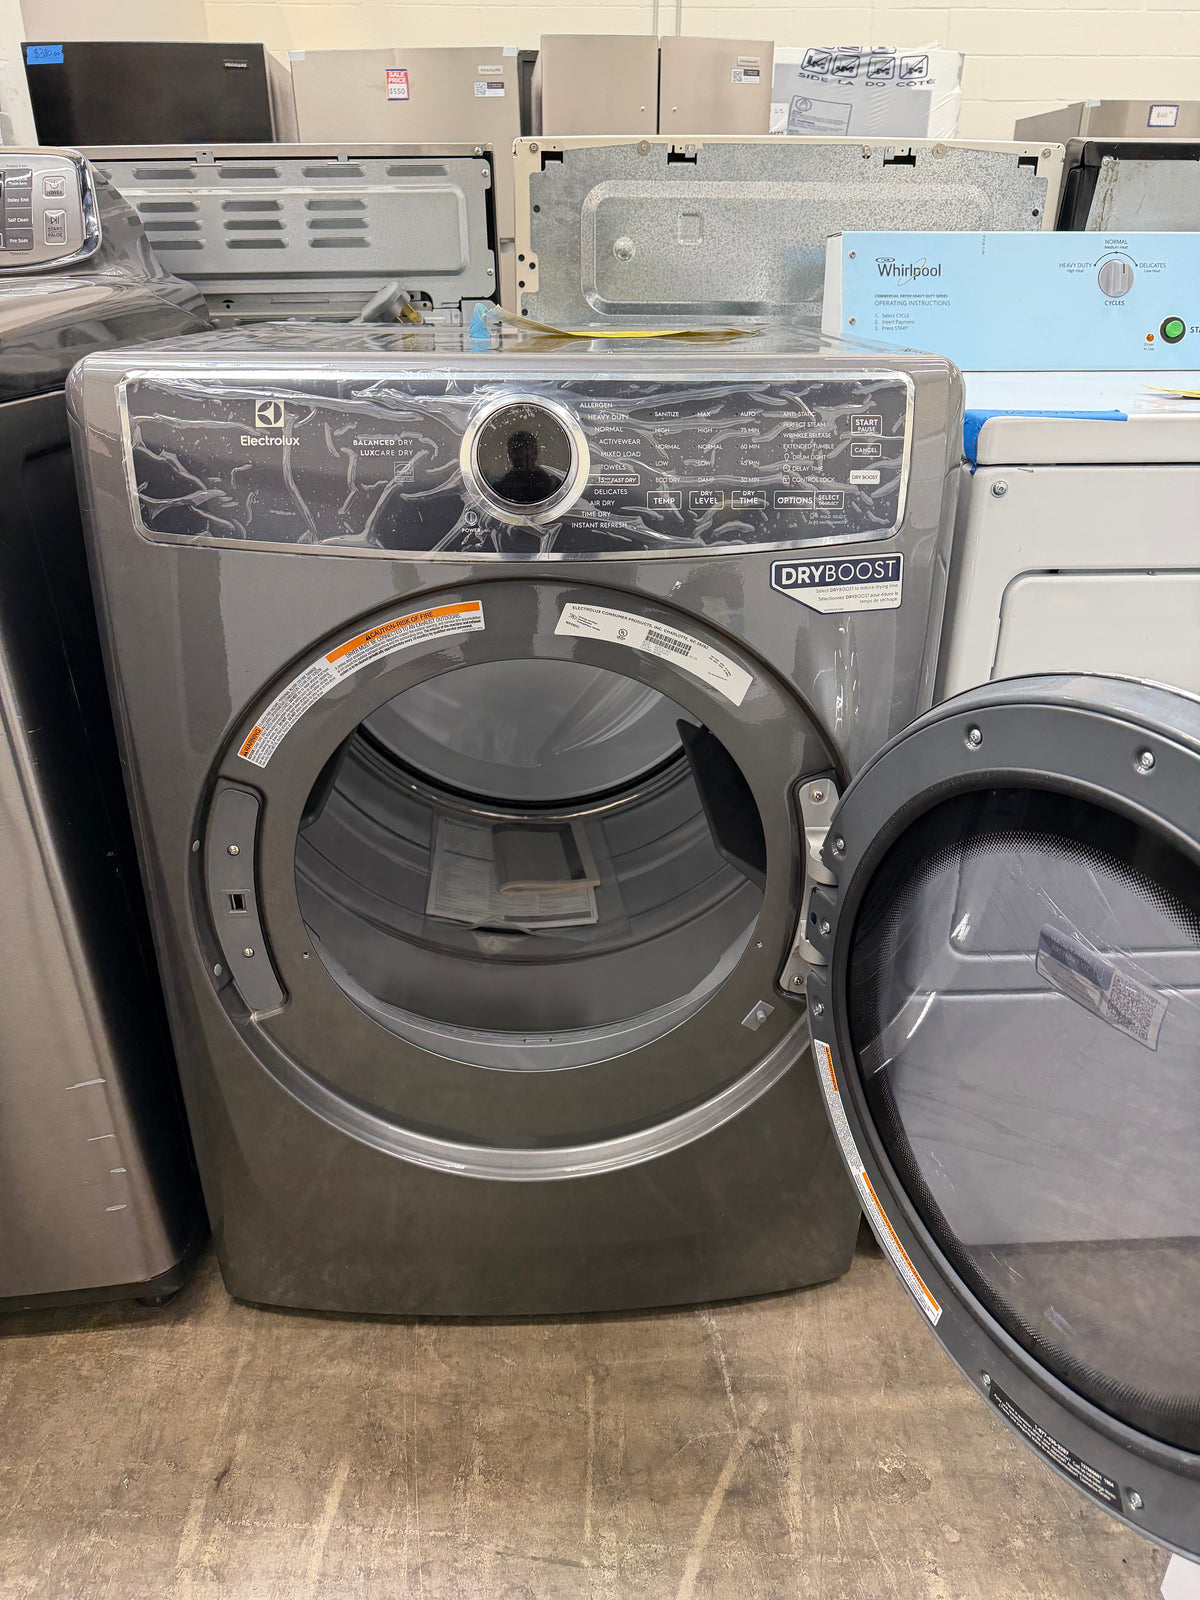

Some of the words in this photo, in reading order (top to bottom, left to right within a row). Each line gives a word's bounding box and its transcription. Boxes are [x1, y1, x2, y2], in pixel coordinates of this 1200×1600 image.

[797, 71, 829, 83] SIDE
[389, 87, 406, 95] $550
[877, 263, 942, 281] Whirlpool
[855, 418, 878, 426] START
[240, 435, 300, 446] Electrolux
[694, 497, 719, 505] LEVEL
[777, 496, 813, 505] OPTIONS
[781, 560, 897, 586] DRYBOOST
[410, 615, 420, 624] OF
[420, 611, 434, 621] FIRE
[572, 605, 601, 614] ELECTROLUX
[601, 610, 628, 620] CONSUMER
[244, 728, 262, 752] WARNING
